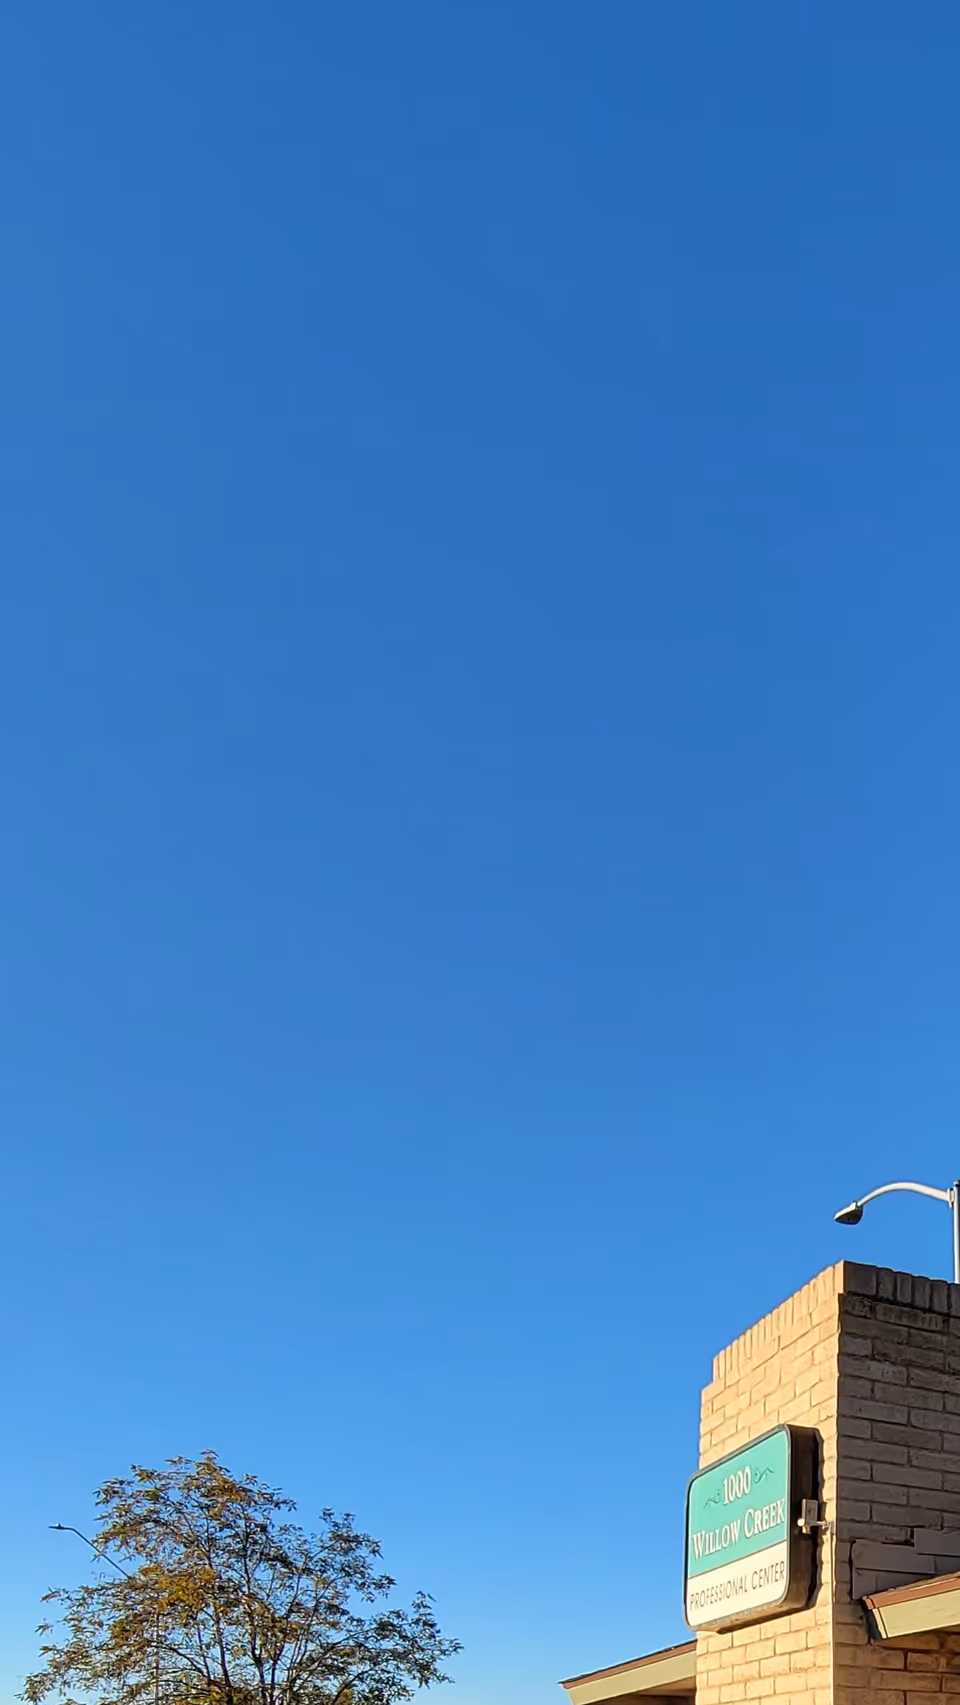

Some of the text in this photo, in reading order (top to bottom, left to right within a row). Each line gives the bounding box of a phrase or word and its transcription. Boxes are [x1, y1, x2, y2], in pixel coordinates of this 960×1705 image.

[723, 1466, 751, 1506] 1000
[692, 1498, 785, 1560] WILLOW CREEK
[690, 1560, 785, 1610] PROFESSIONAL CENTER
